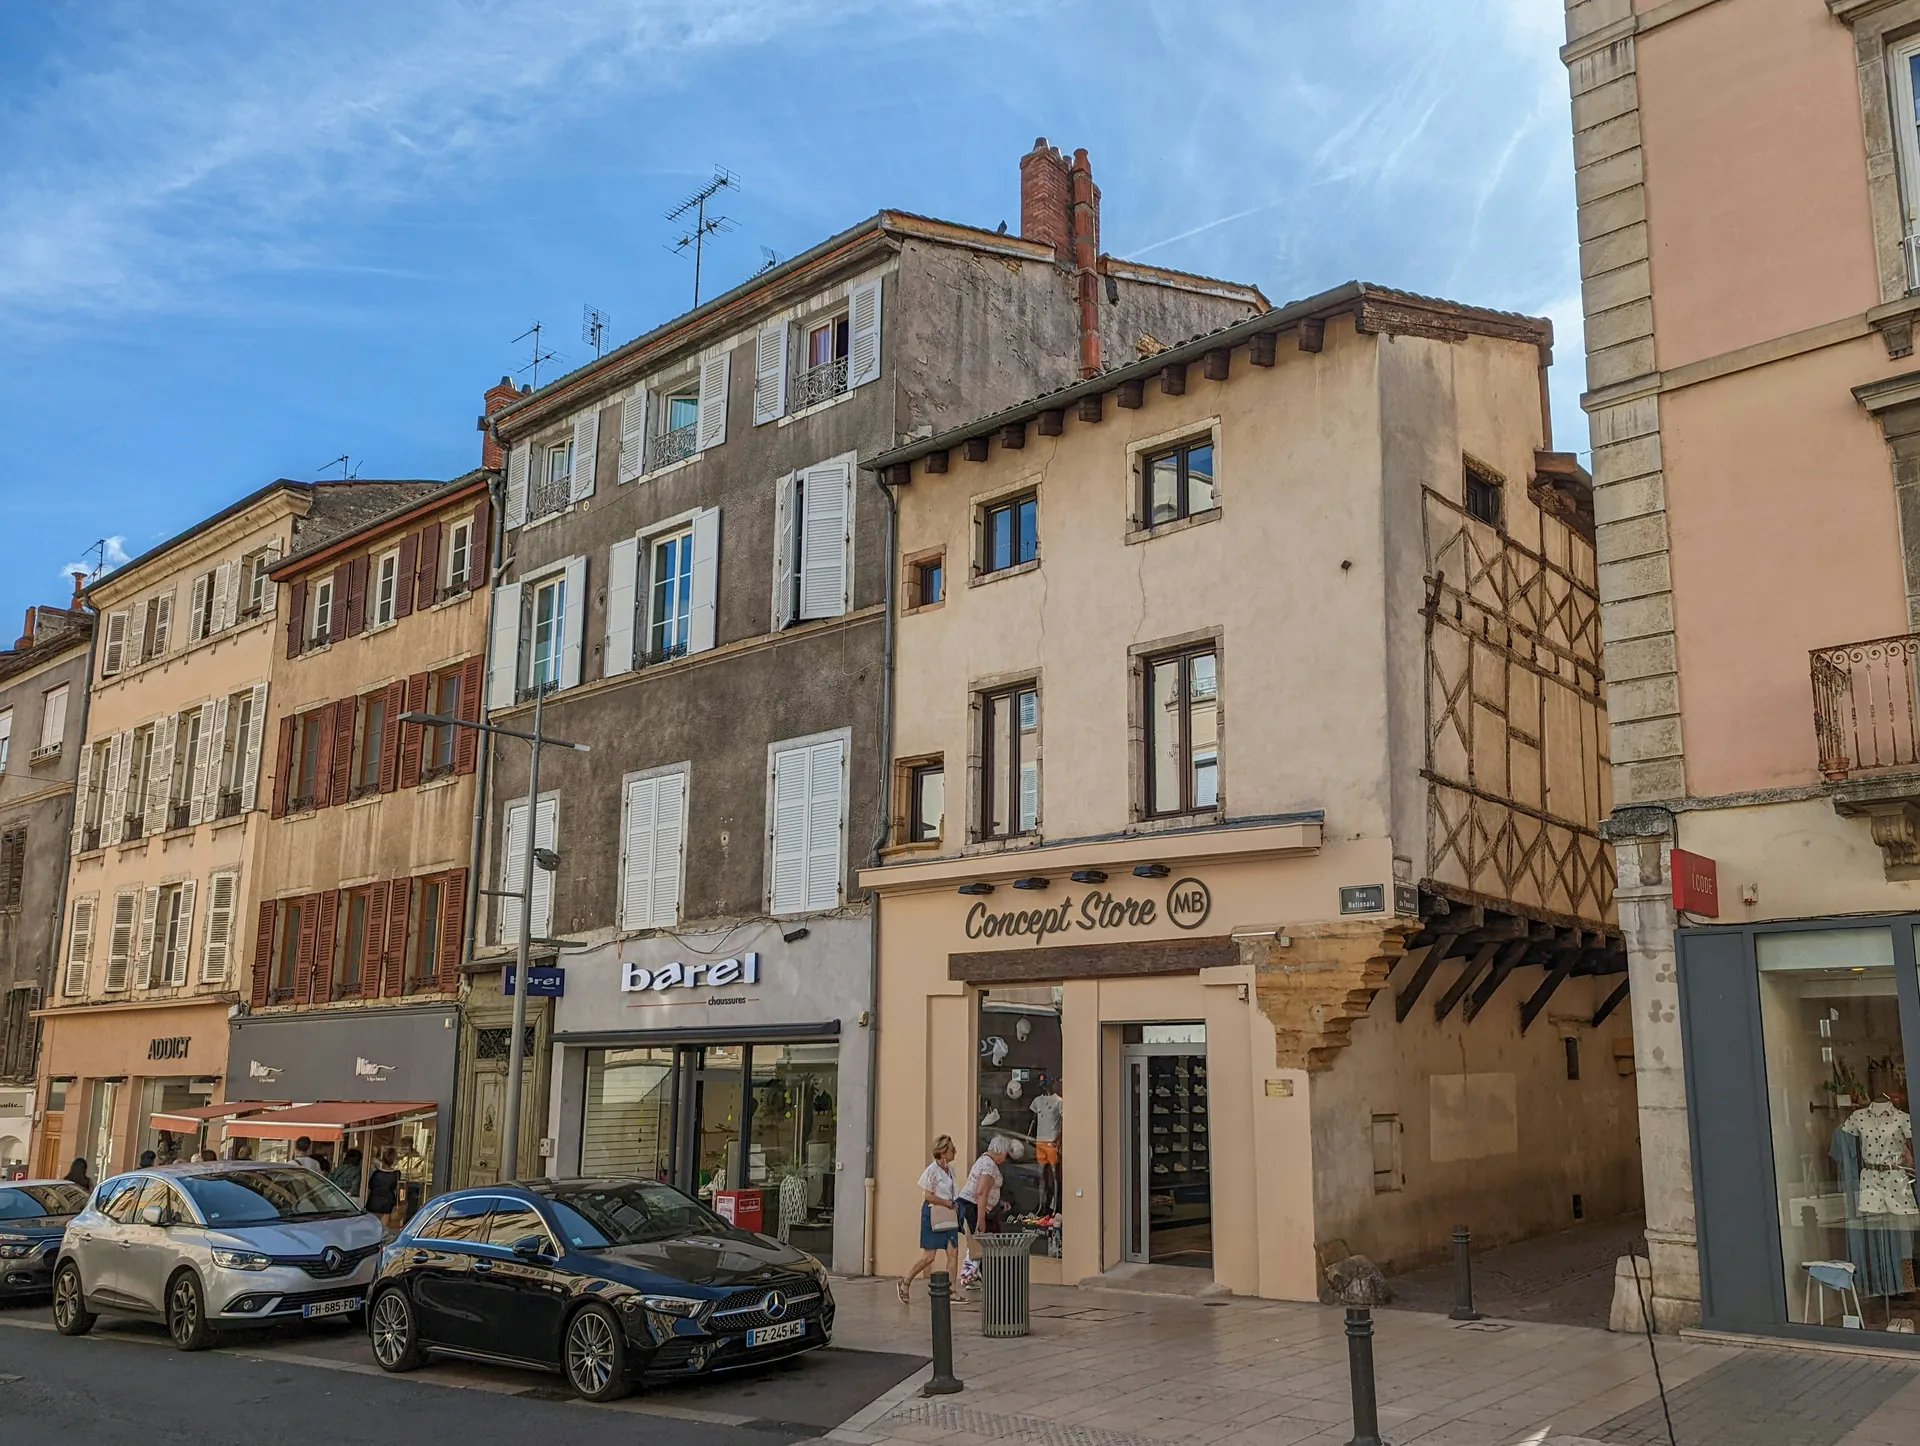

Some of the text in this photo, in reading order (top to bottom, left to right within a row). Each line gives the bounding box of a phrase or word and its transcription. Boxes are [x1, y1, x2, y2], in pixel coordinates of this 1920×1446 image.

[965, 890, 1204, 946] Concept Store MB
[621, 952, 758, 992] barel
[707, 995, 747, 1006] chaussures
[147, 1036, 192, 1061] ADDICT
